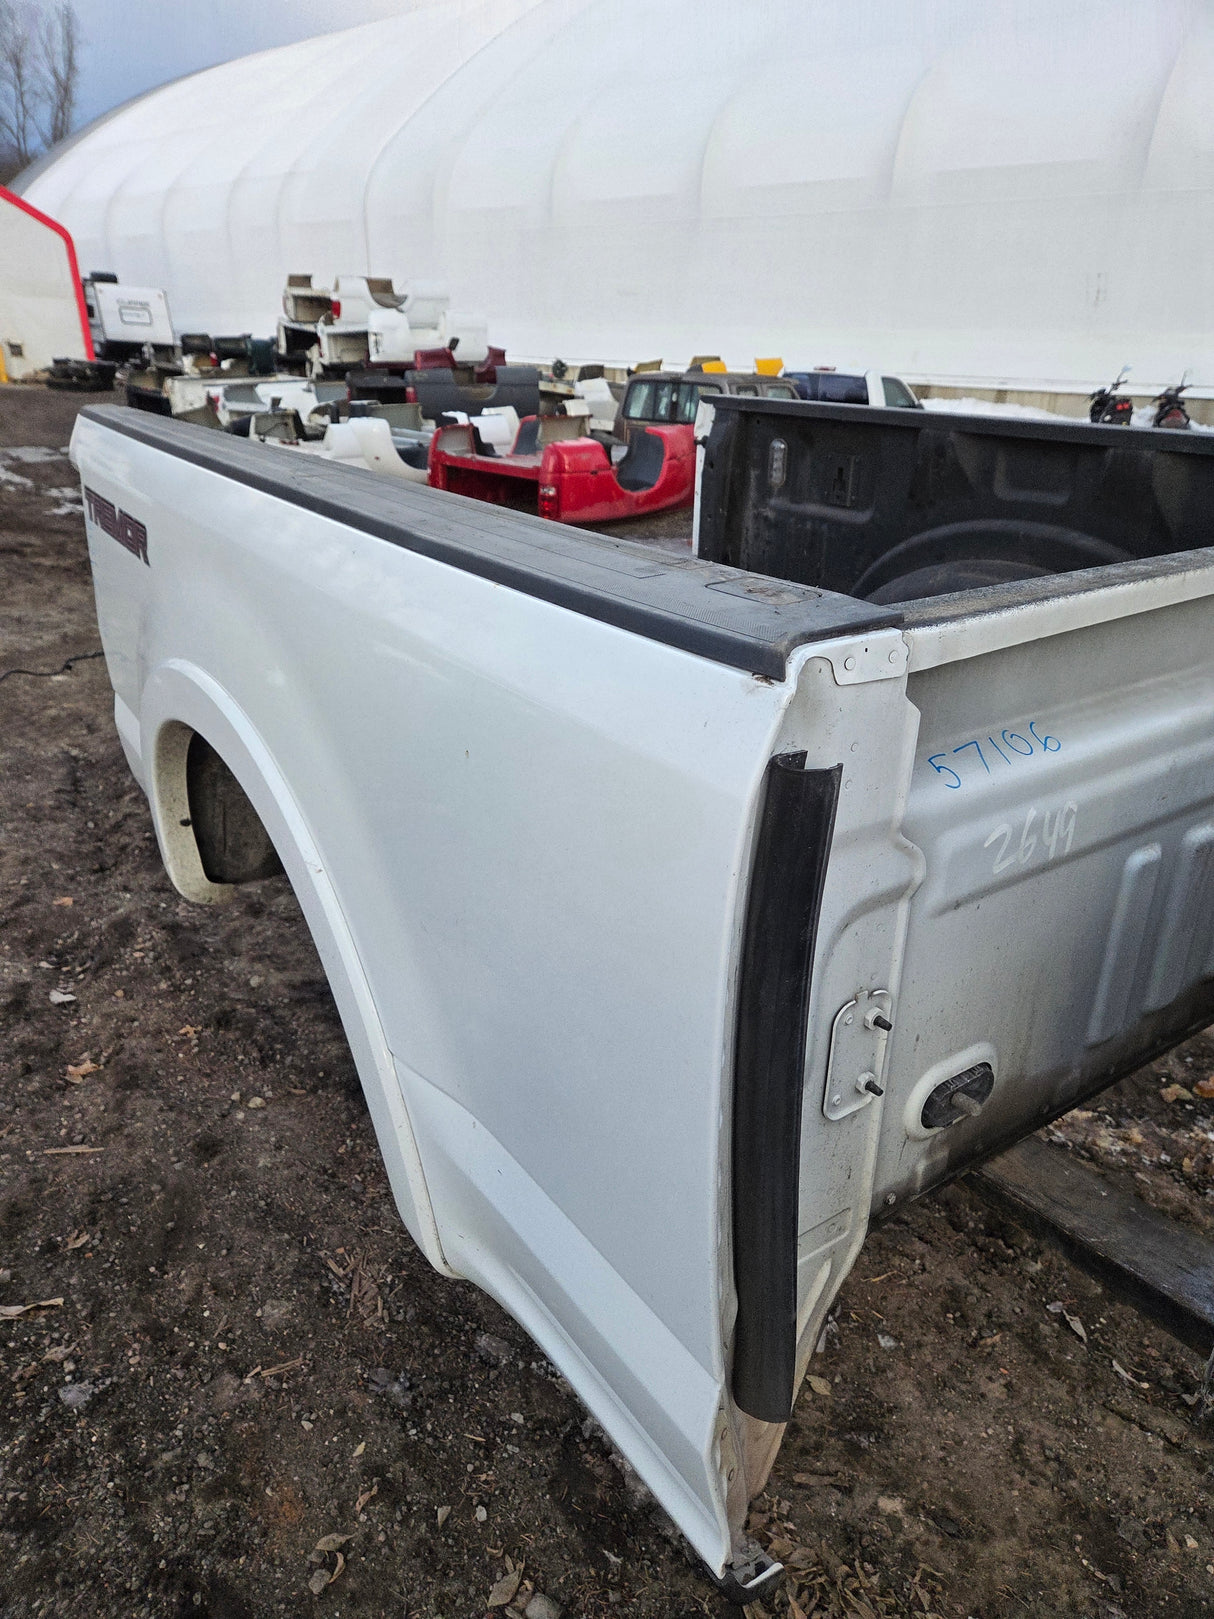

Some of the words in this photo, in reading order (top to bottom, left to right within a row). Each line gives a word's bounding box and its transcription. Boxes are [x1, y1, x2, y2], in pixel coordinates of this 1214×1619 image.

[84, 485, 150, 567] TREMOR
[928, 721, 1061, 789] 57106
[983, 801, 1078, 874] 2649
